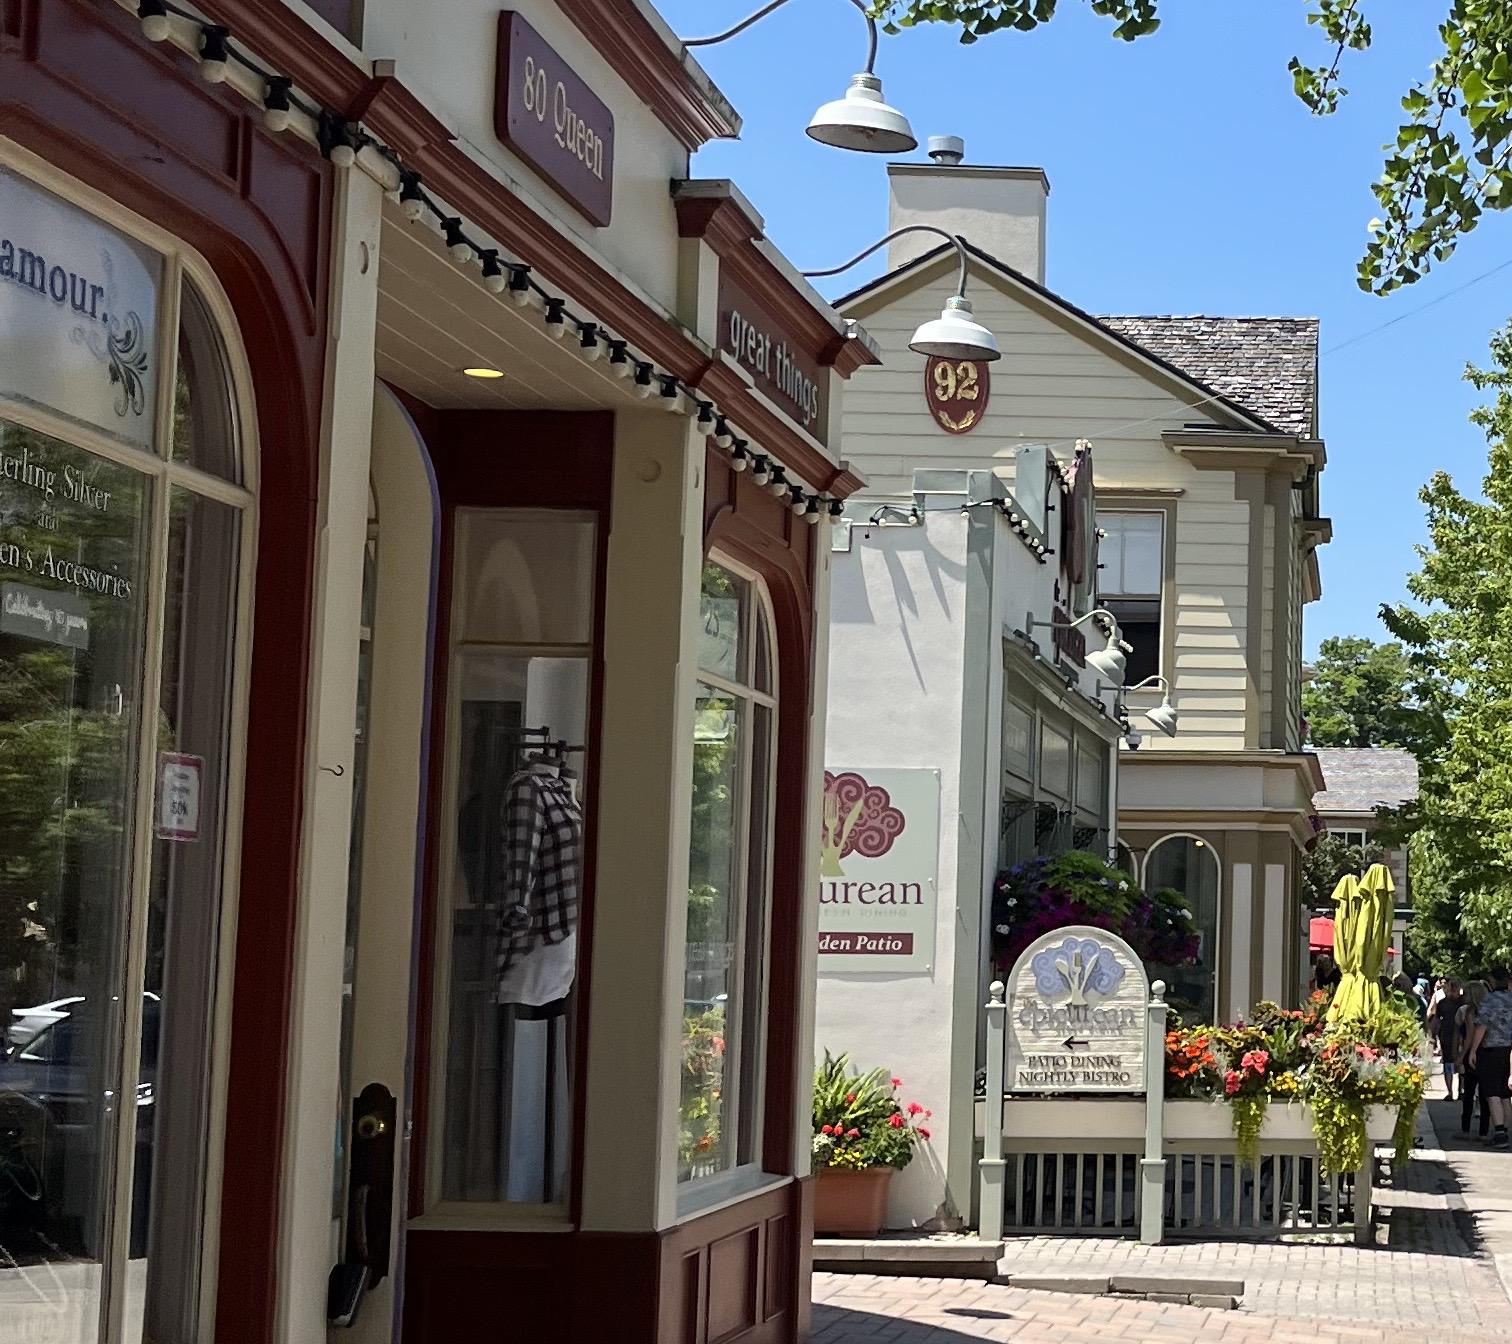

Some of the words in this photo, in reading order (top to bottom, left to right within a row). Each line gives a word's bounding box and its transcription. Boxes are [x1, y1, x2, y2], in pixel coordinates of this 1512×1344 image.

[523, 56, 547, 122] 80
[554, 81, 604, 181] Queen
[730, 310, 772, 379] great
[776, 341, 818, 425] things
[933, 360, 979, 402] 92
[64, 464, 112, 512] Silver
[40, 544, 133, 600] Accessories
[820, 881, 924, 905] urean
[820, 935, 851, 951] den
[855, 936, 903, 951] Patio
[1019, 1071, 1080, 1083] NIGHTLY
[1083, 1071, 1131, 1083] BISTRO
[1028, 1056, 1067, 1068] PATIO
[1071, 1056, 1121, 1069] DINING
